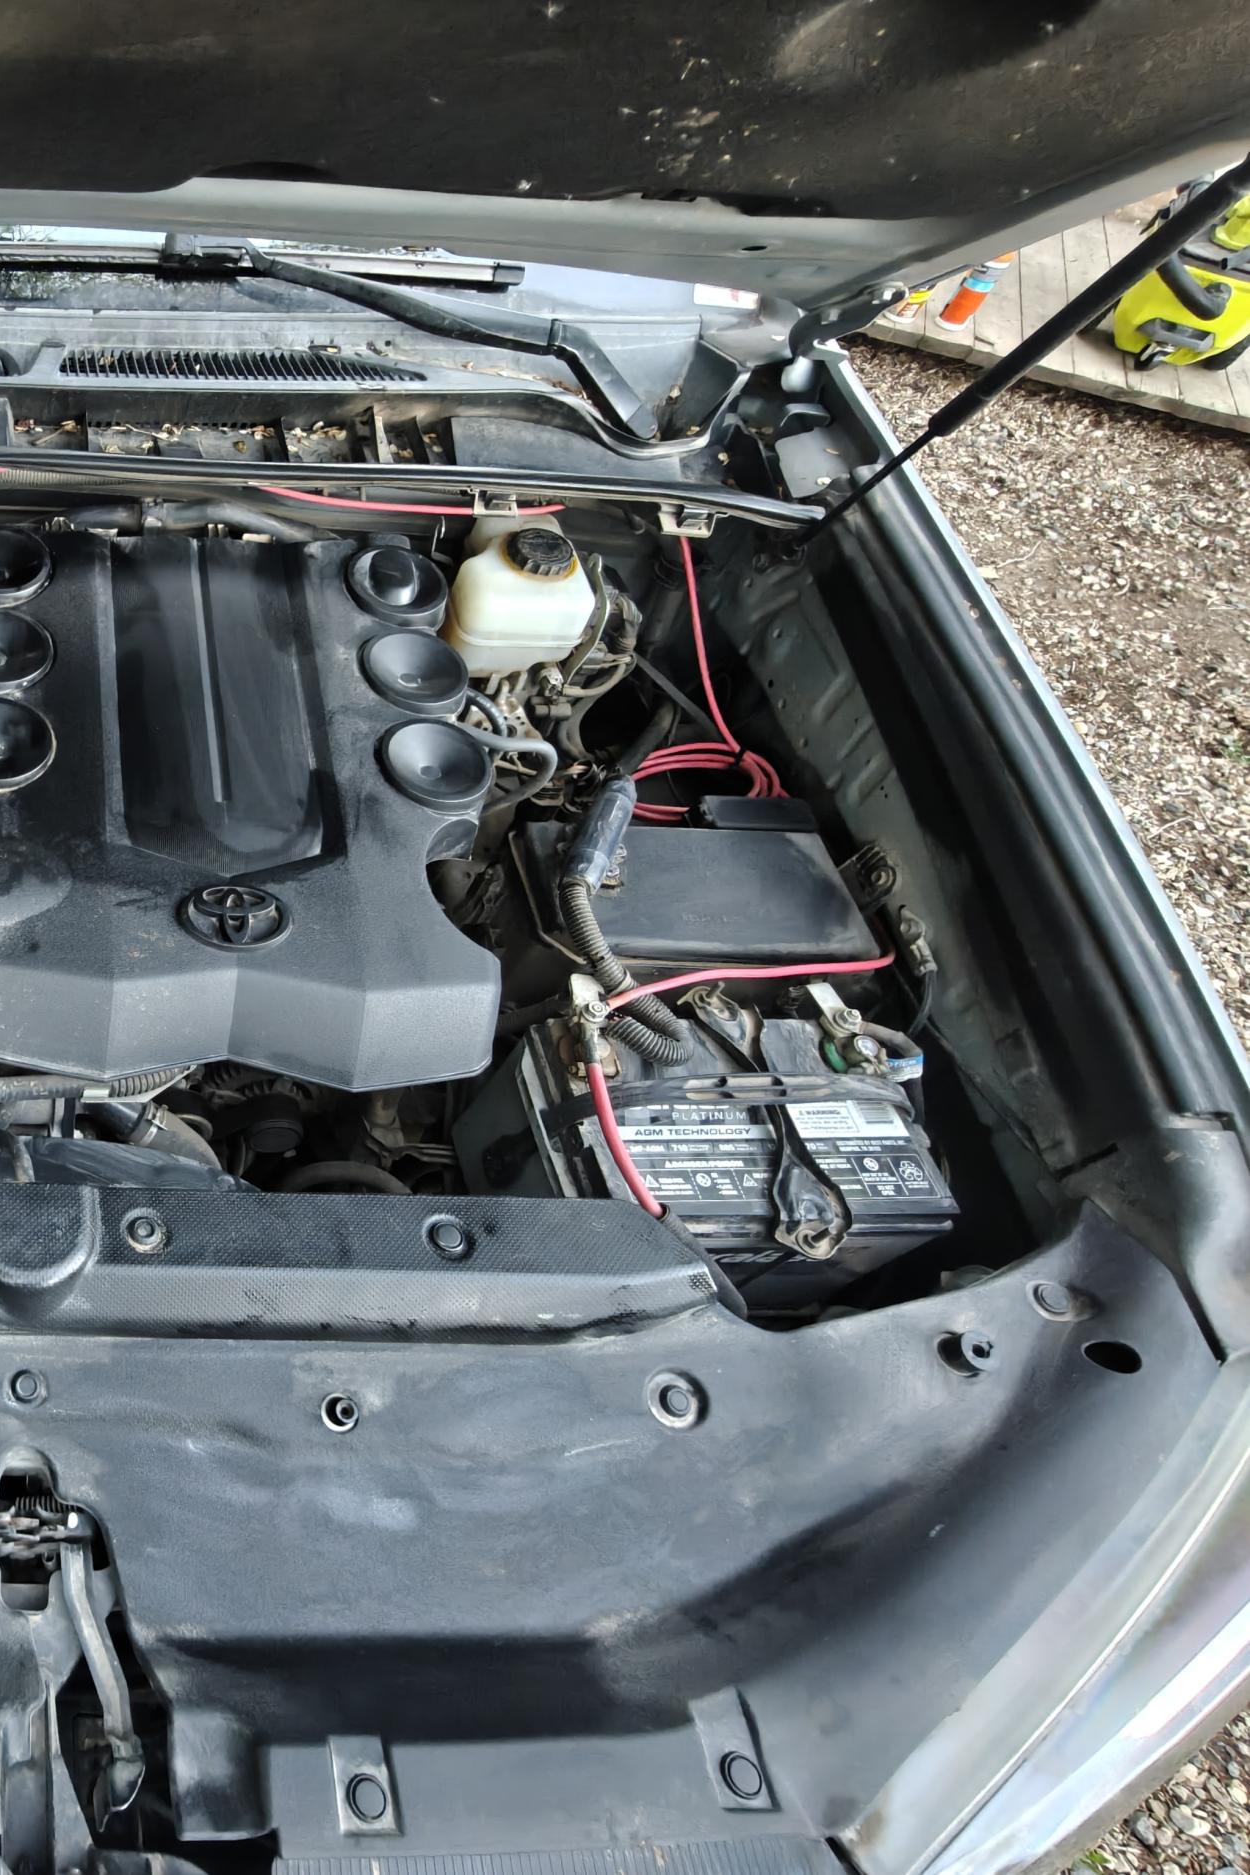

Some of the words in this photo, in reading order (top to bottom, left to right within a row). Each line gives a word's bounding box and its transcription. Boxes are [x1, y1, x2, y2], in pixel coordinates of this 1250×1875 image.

[672, 1111, 747, 1121] PLATINUM
[634, 1128, 664, 1136] AGM
[667, 1127, 751, 1136] TECHNOLOGY
